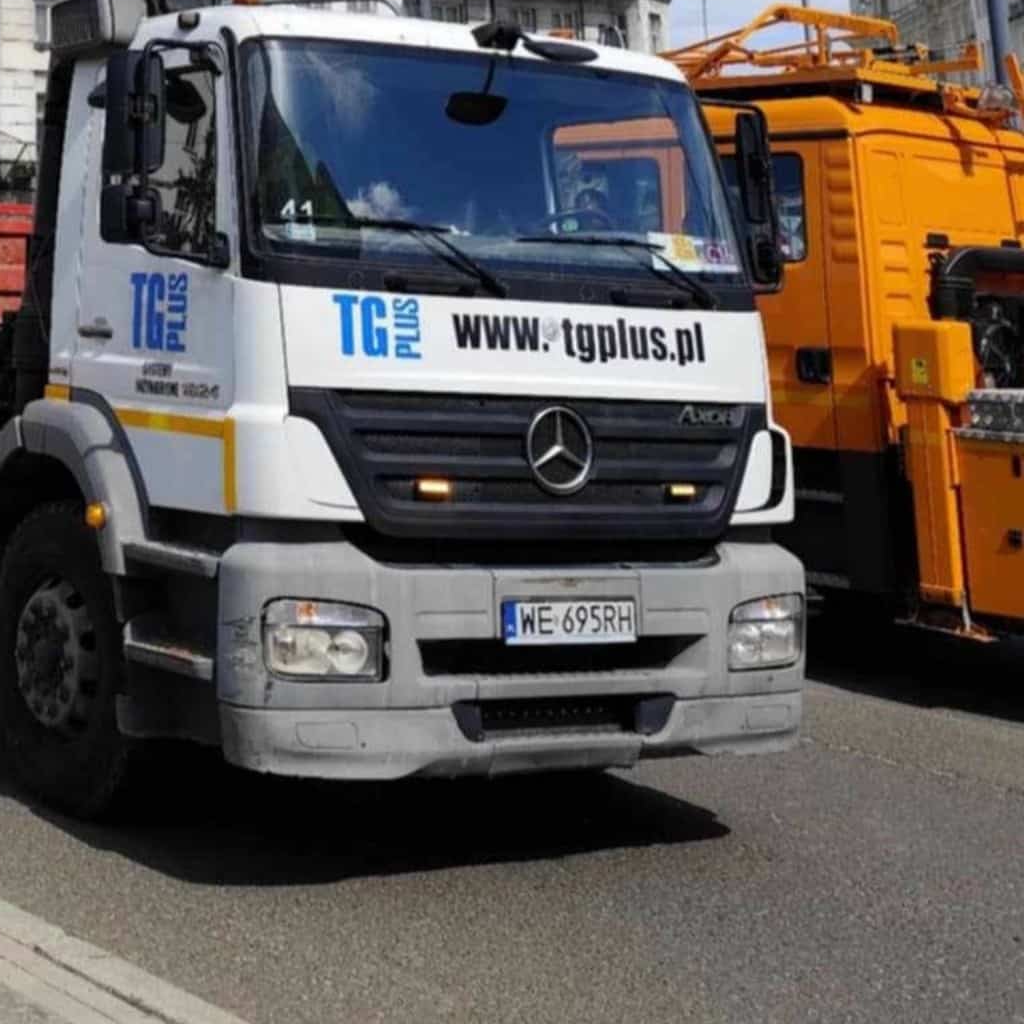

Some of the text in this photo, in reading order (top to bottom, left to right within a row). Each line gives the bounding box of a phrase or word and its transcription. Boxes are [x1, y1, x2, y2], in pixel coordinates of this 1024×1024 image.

[131, 273, 188, 352] TG PLUS
[332, 293, 422, 360] TG PLUS
[520, 605, 633, 634] WE 695RH
